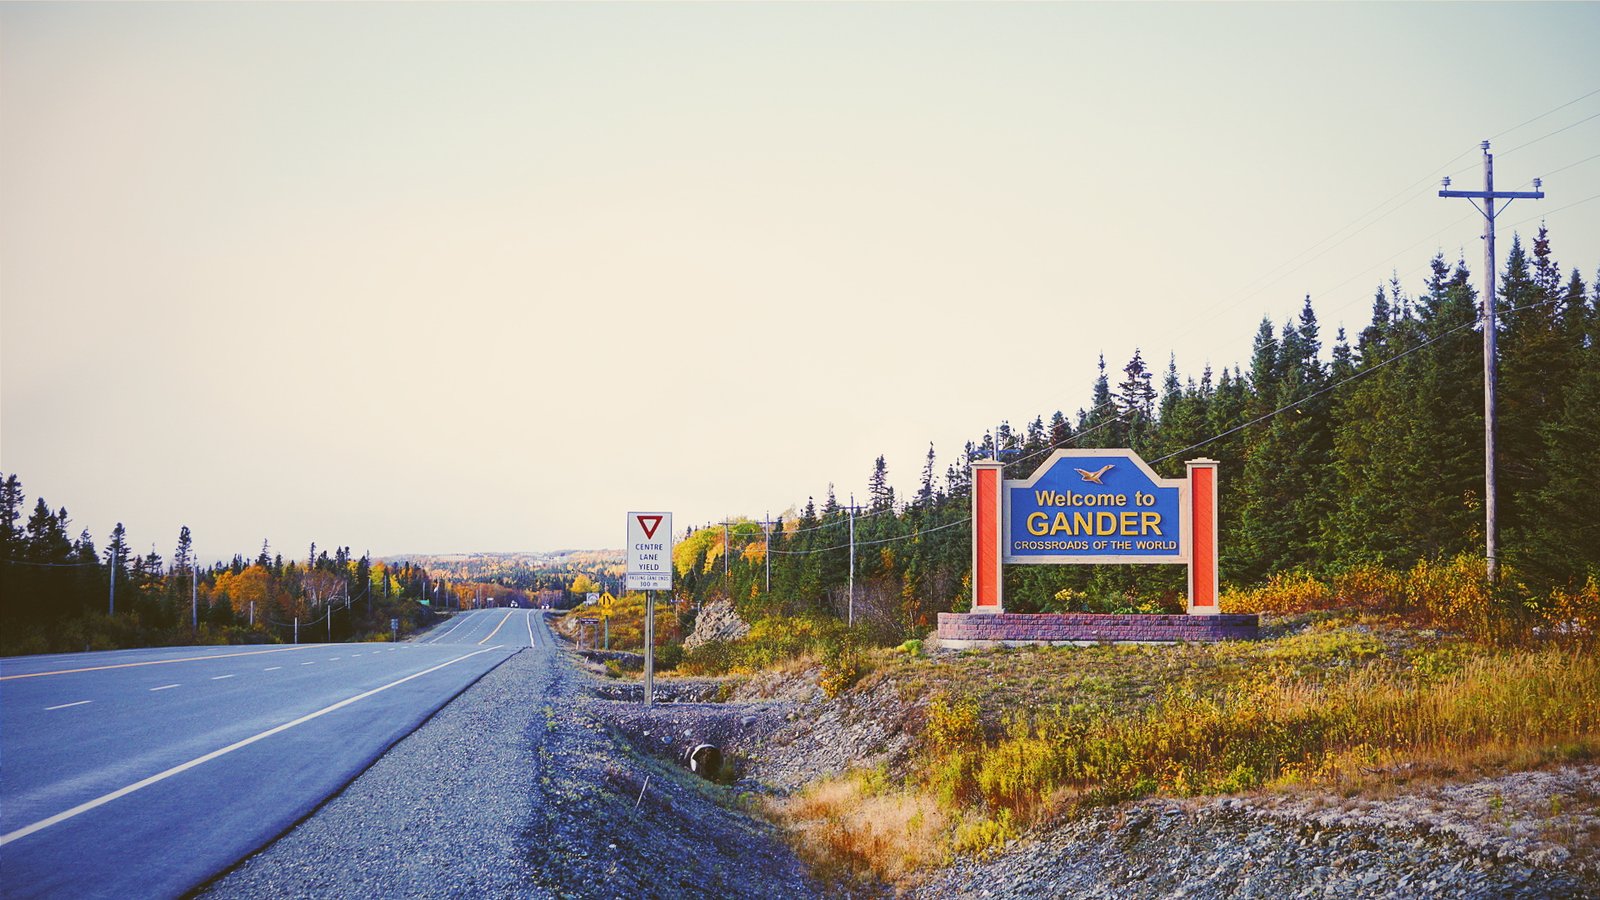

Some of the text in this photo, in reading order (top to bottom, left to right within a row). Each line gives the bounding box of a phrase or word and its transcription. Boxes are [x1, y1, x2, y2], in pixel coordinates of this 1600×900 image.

[1035, 490, 1155, 507] Welcome to
[1026, 511, 1162, 536] GANDER
[1014, 540, 1177, 550] CROSSROADS OF THE WORLD
